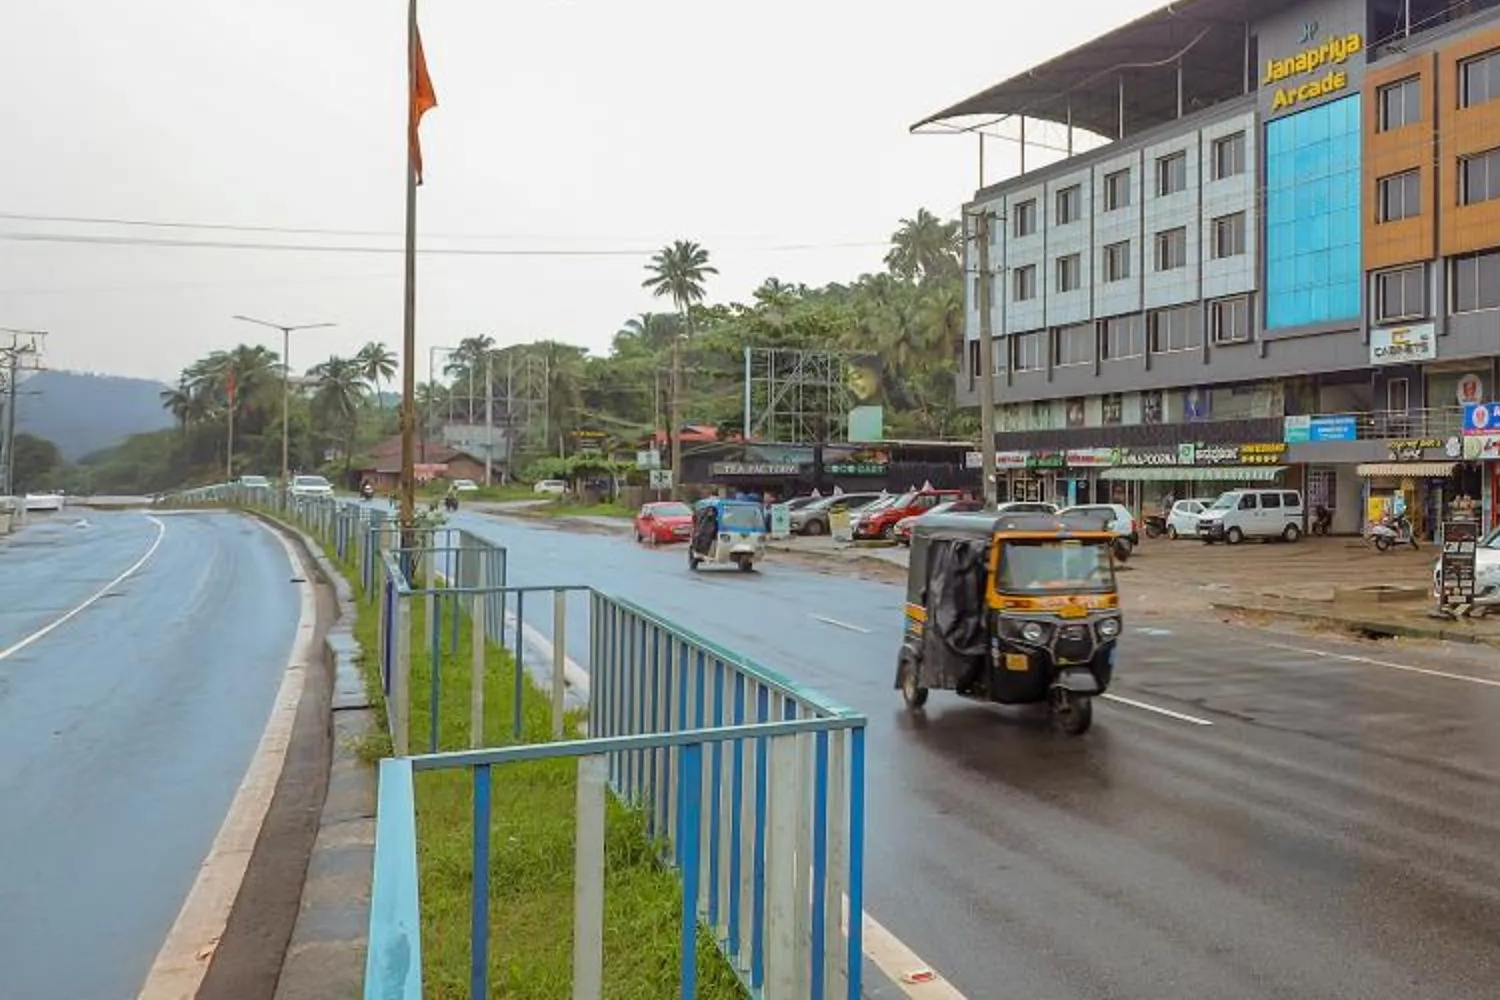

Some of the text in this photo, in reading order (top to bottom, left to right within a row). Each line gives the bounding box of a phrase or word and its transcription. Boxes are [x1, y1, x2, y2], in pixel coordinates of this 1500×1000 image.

[1264, 32, 1362, 86] Janapriya
[1271, 70, 1347, 113] Arcade
[723, 464, 797, 475] TEA FACTORY
